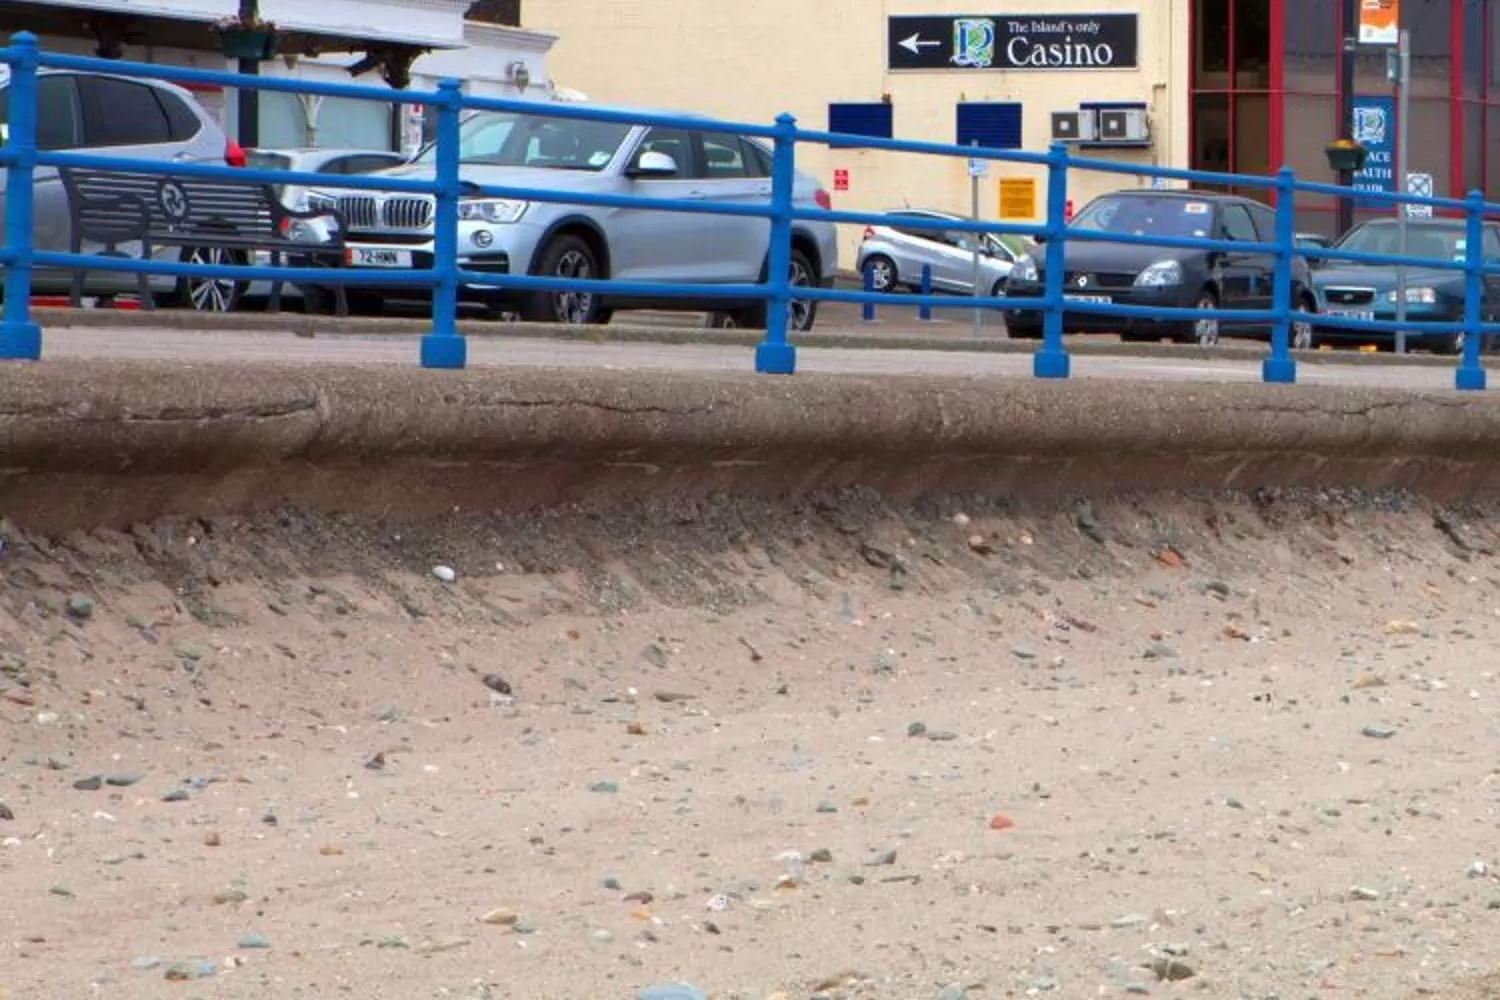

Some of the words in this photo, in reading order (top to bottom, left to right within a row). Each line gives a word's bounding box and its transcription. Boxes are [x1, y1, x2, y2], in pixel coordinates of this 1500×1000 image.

[1008, 21, 1028, 33] The
[1031, 20, 1073, 33] Island's
[1076, 20, 1101, 34] only
[1007, 36, 1113, 66] Casino
